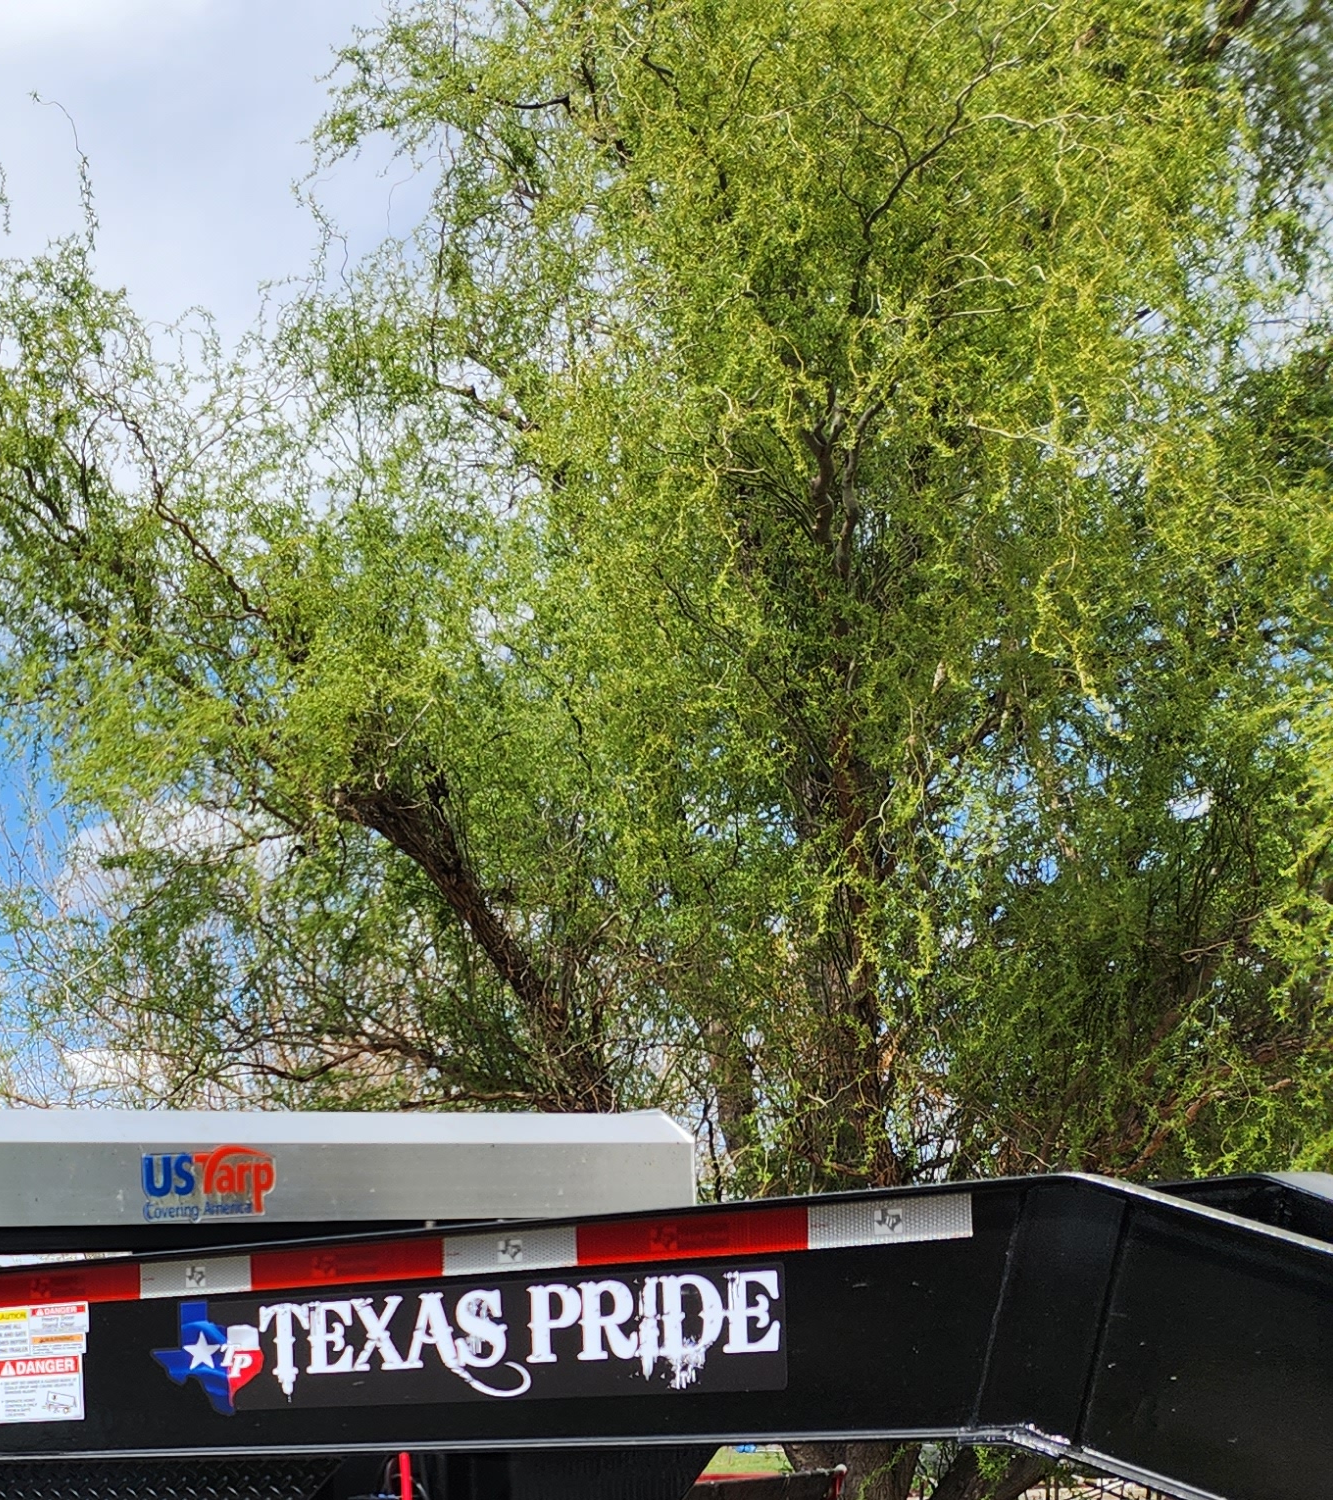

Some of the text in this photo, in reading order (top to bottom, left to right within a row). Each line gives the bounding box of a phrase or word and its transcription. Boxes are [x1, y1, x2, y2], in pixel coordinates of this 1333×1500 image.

[145, 1201, 252, 1220] Covering America
[45, 1306, 77, 1315] DANGER
[259, 1269, 781, 1402] TEXAS PRIDE
[16, 1358, 75, 1375] DANGER
[220, 1343, 253, 1378] TP
